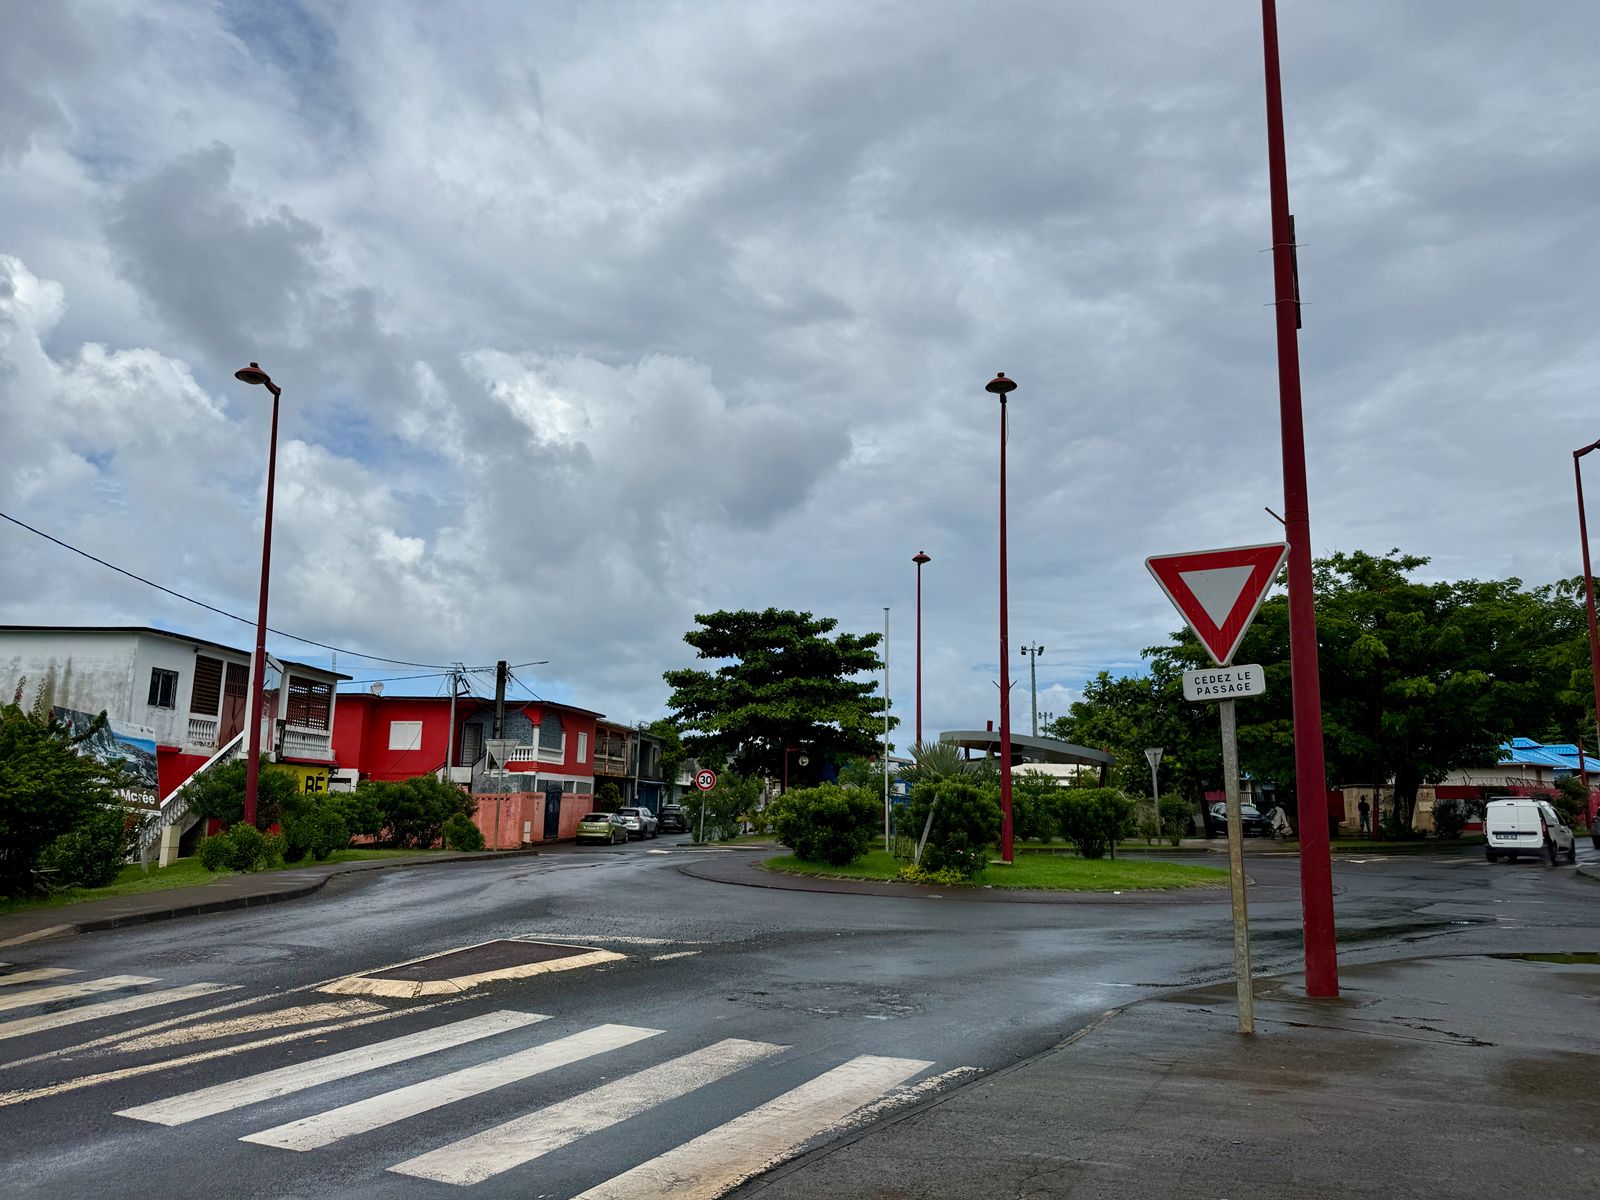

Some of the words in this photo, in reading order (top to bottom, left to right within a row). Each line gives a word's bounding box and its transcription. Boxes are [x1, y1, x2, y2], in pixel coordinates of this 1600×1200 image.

[1194, 673, 1231, 685] CÉDEZ
[1237, 671, 1251, 680] LE
[1196, 682, 1251, 696] PASSAGE
[700, 775, 712, 785] 30
